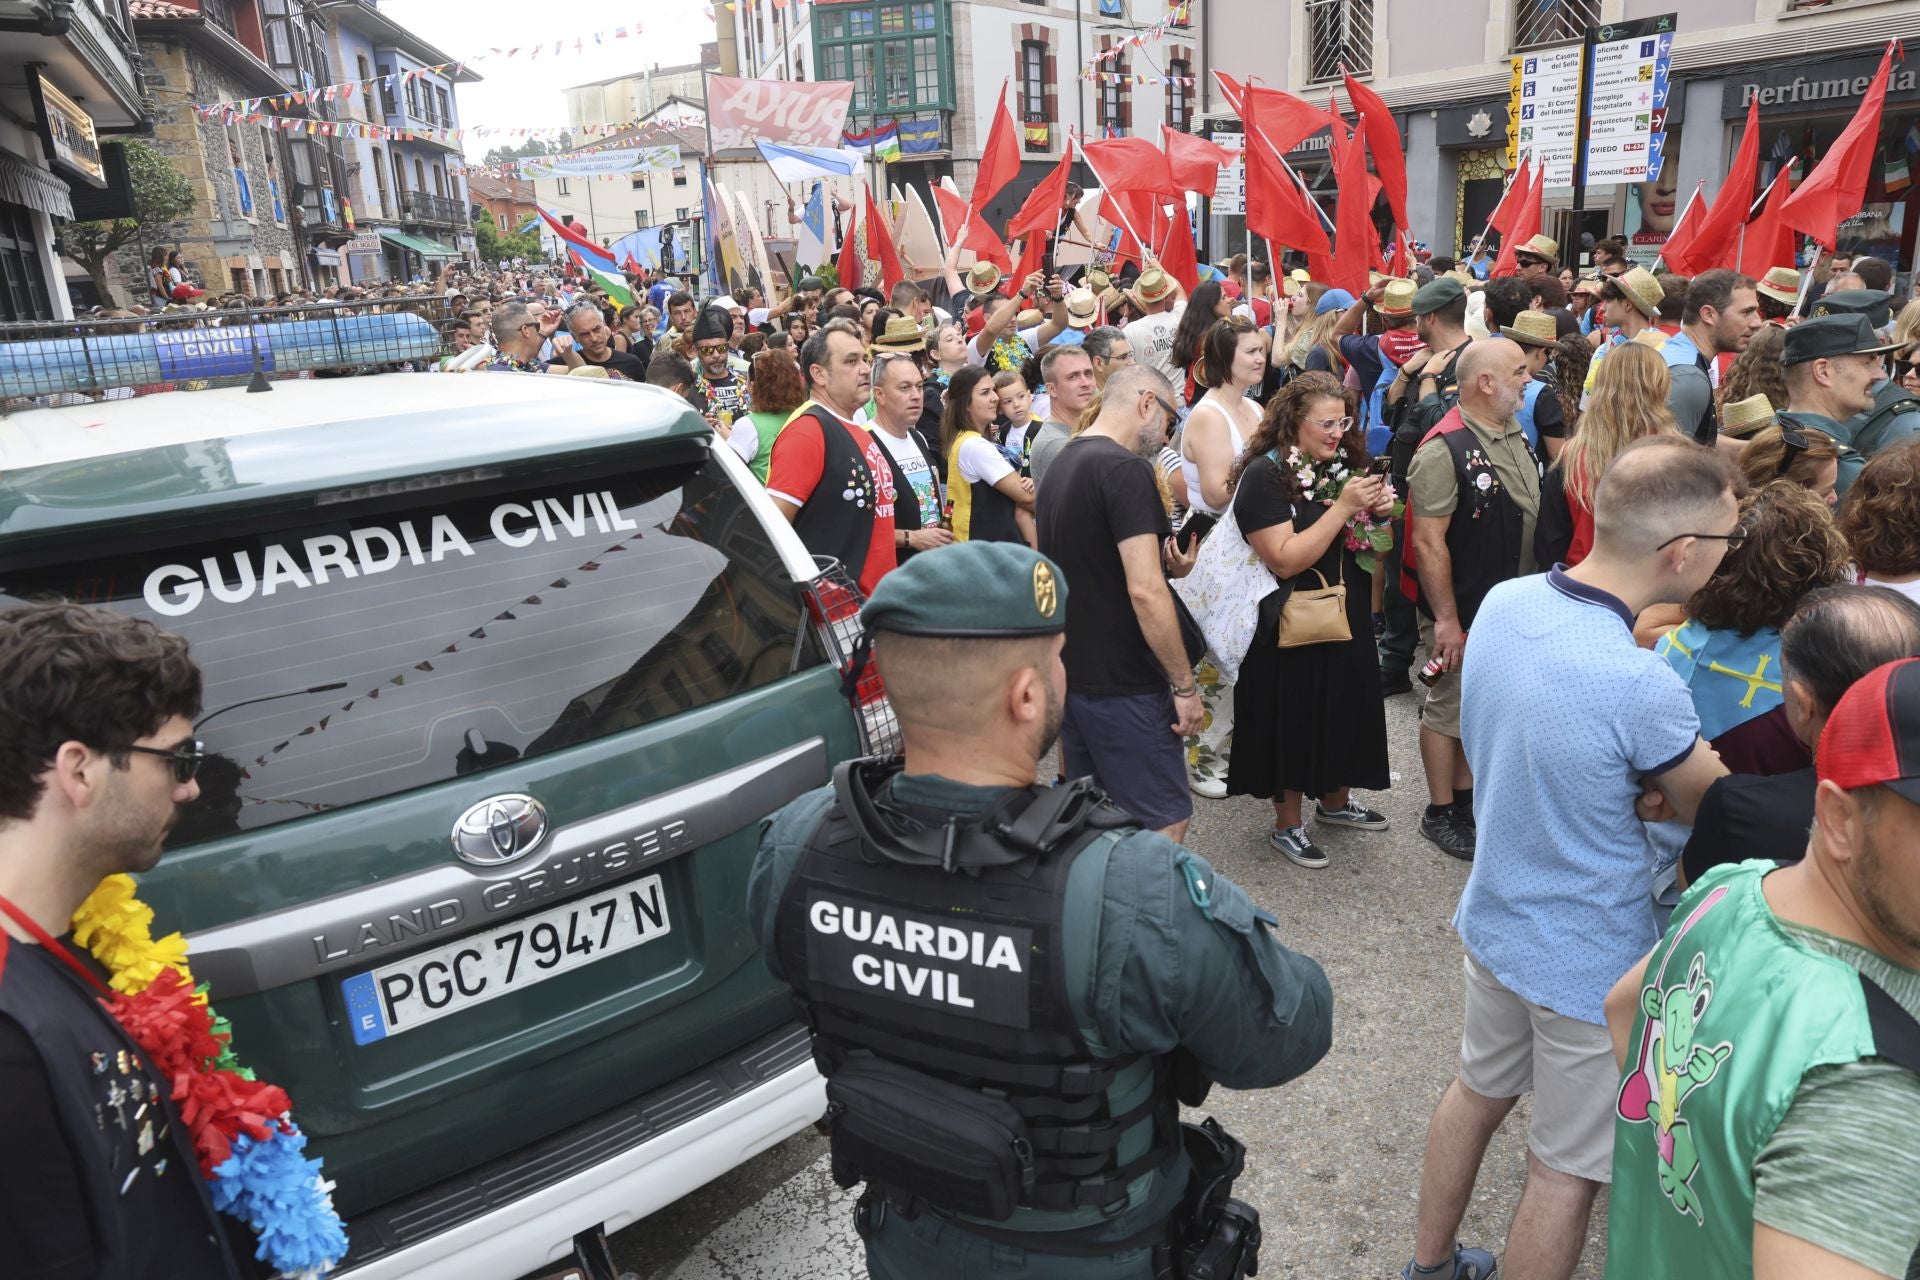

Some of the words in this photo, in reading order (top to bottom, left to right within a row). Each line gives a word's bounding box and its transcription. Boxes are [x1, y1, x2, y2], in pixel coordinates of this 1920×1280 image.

[1597, 45, 1619, 54] oficina
[1556, 52, 1578, 60] Casona
[1596, 54, 1622, 63] turismo
[1552, 62, 1562, 70] del
[1563, 60, 1578, 68] Sella
[1552, 83, 1577, 93] Español
[1740, 64, 1916, 108] Perfumeía
[1556, 99, 1576, 107] Corral
[1593, 94, 1624, 103] complejo
[1592, 101, 1632, 111] hospitalario
[1592, 116, 1633, 126] arquitectura
[1590, 145, 1618, 154] OVIEDO
[1624, 143, 1645, 151] N-634
[1588, 168, 1623, 177] SANTANDER
[1624, 166, 1646, 174] N-634
[1544, 176, 1571, 184] Piraguas
[158, 326, 258, 345] GUARDIA
[185, 340, 244, 356] CIVIL
[1153, 336, 1175, 352] VANS
[899, 457, 927, 472] PILOÑA
[143, 515, 475, 617] GUARDIA
[490, 490, 637, 549] CIVIL
[312, 898, 466, 967] LAND
[482, 819, 693, 913] CRUISER
[810, 900, 1022, 973] GUARDIA
[380, 948, 488, 1026] PGC
[494, 898, 619, 984] 7947
[629, 883, 665, 936] N
[852, 953, 975, 1008] CIVIL
[362, 1014, 376, 1031] E
